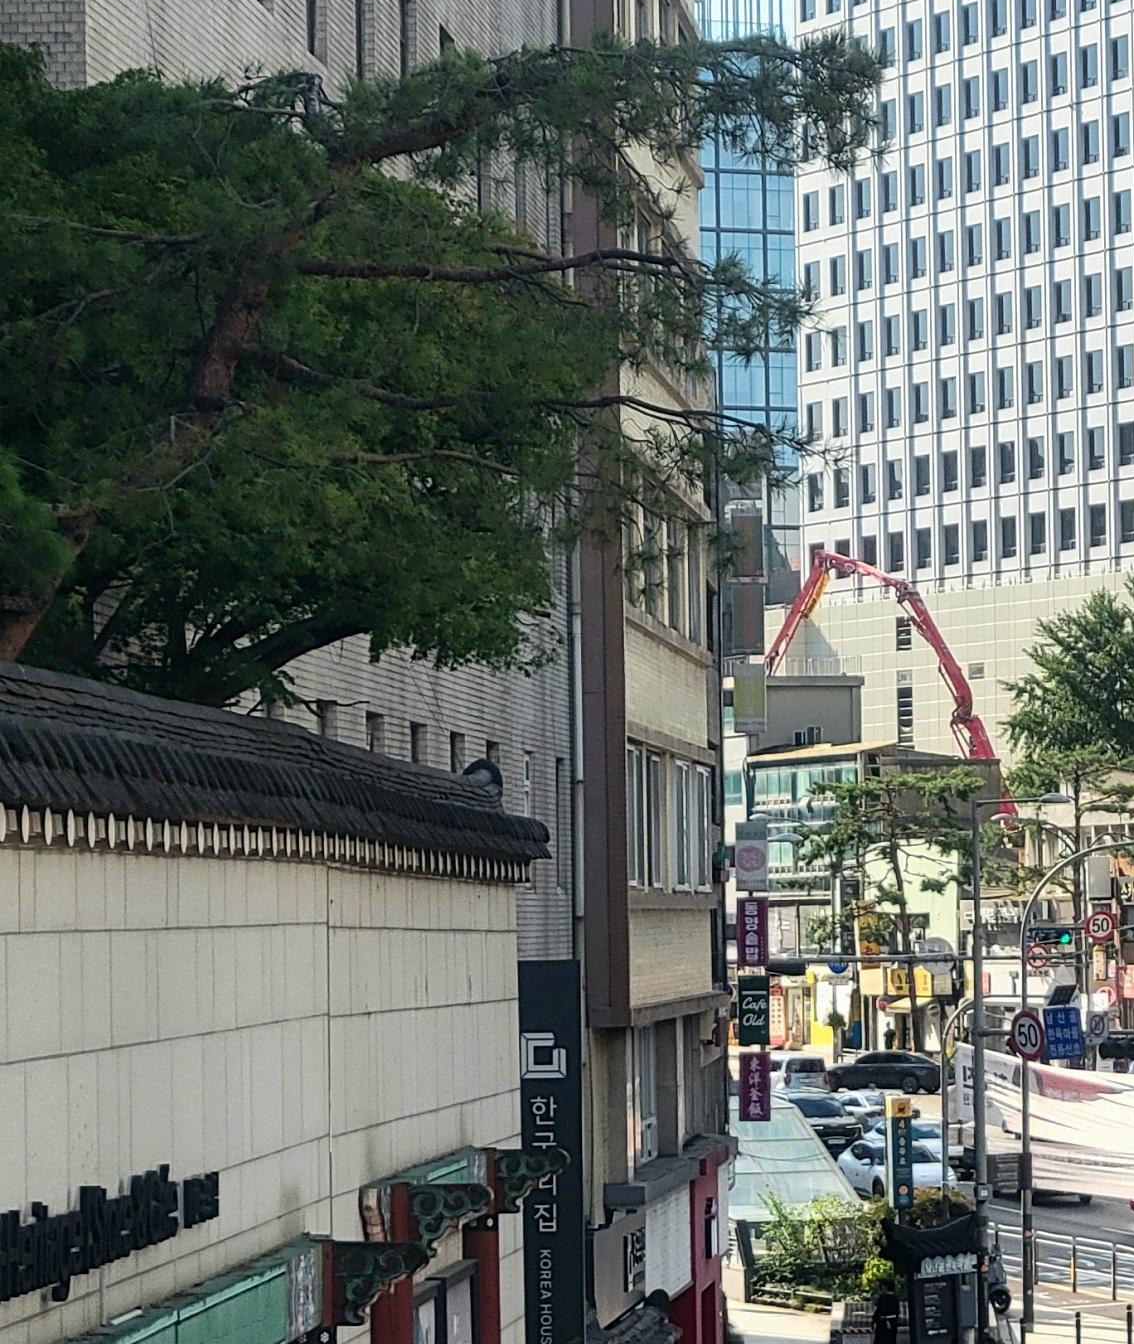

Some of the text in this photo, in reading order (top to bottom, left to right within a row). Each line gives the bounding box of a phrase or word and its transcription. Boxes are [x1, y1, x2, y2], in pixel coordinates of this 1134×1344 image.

[1092, 917, 1110, 933] 50
[742, 996, 767, 1010] Cafe
[742, 1013, 766, 1026] Old
[1018, 1023, 1038, 1048] 50
[539, 1248, 552, 1300] KOREA
